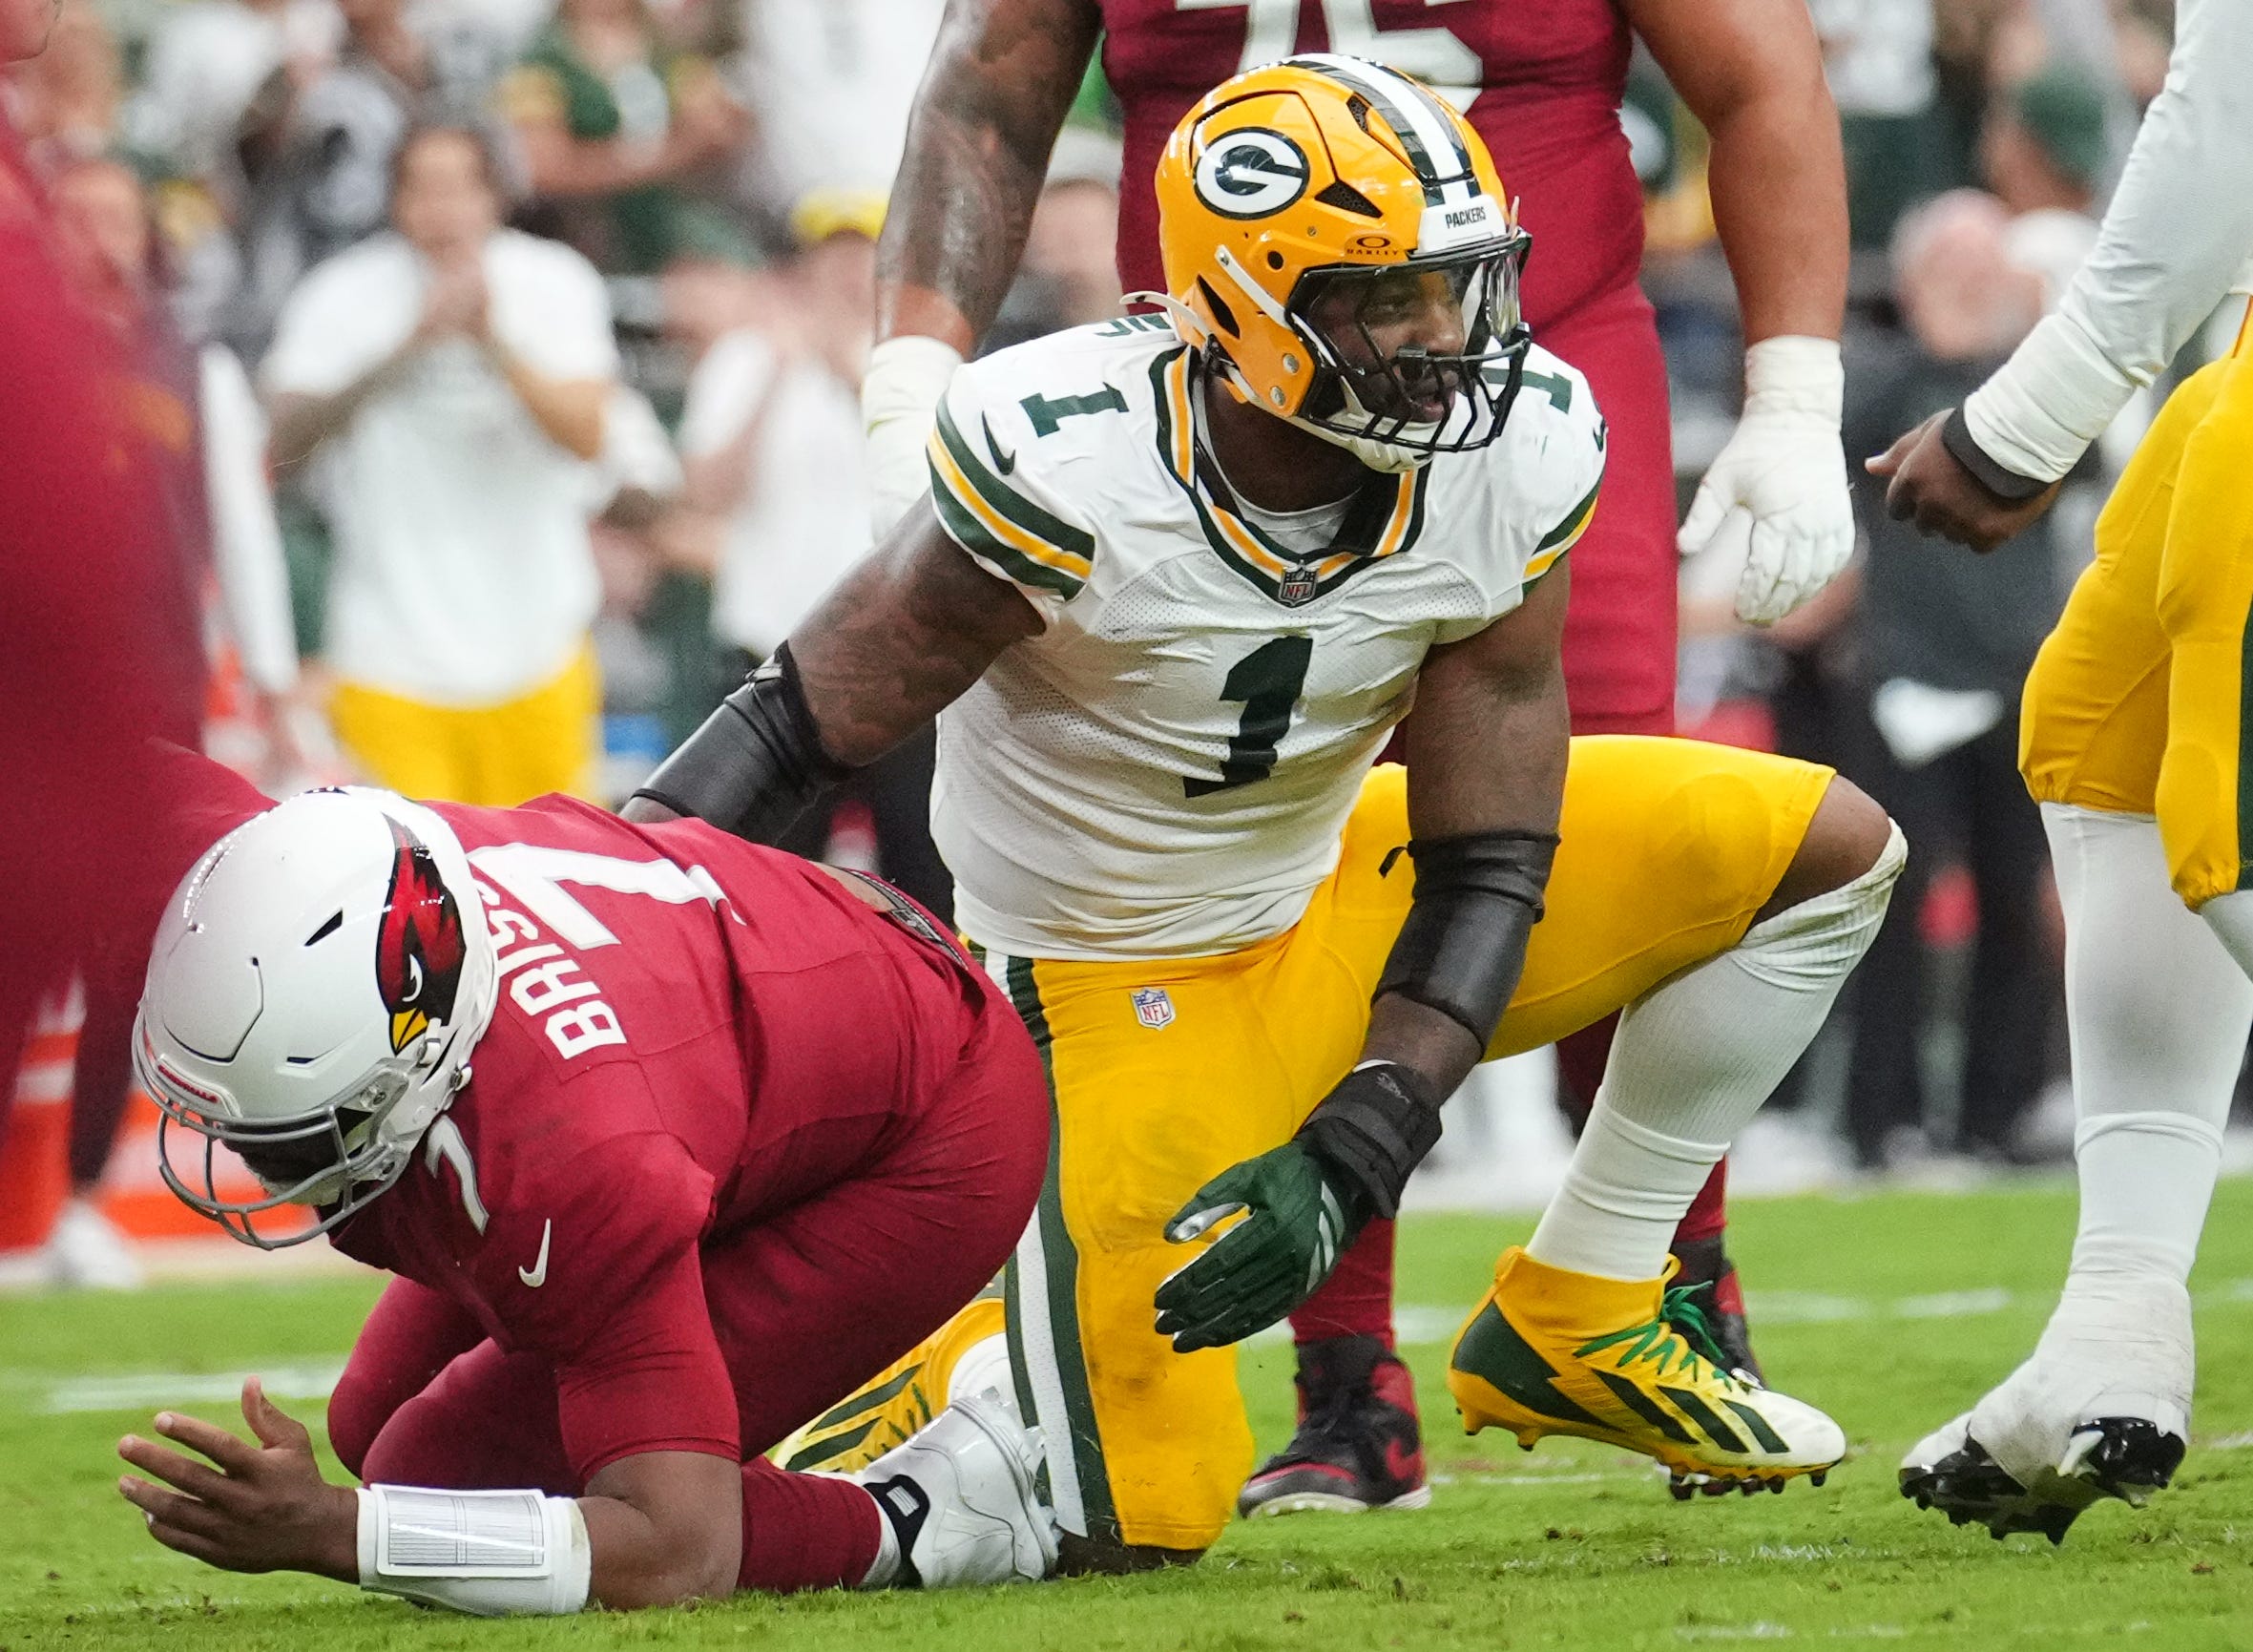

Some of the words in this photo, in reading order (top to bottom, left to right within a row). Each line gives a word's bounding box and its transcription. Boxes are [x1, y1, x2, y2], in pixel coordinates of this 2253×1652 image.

[1445, 206, 1487, 229] PACKERS
[1018, 381, 1130, 438] 1
[1284, 584, 1311, 600] NFL
[1183, 635, 1313, 798] 1
[466, 842, 747, 951] 7
[1142, 1003, 1169, 1022] NFL
